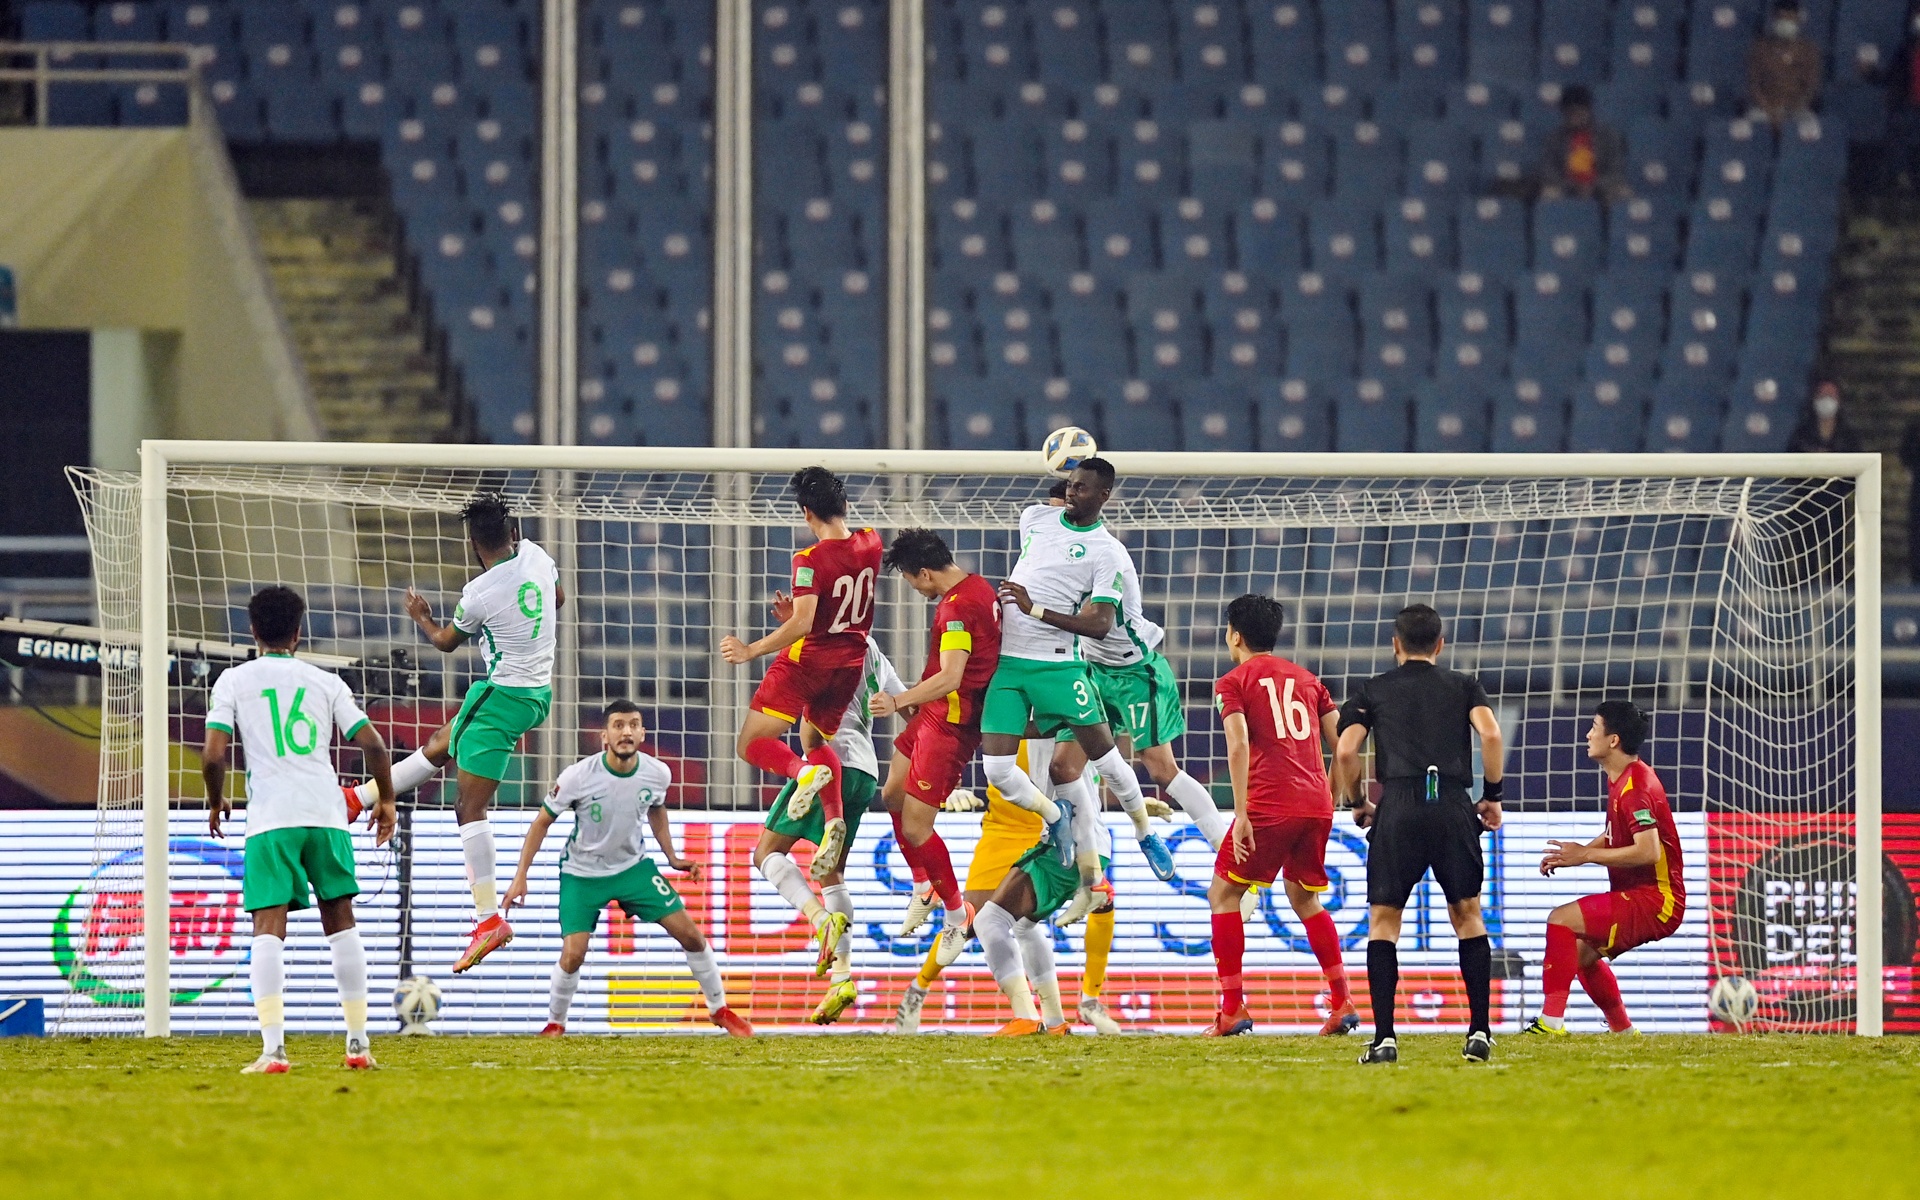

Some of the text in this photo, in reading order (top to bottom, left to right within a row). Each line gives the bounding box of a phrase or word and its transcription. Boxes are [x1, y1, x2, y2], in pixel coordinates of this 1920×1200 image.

[517, 581, 543, 639] 9
[828, 567, 874, 634] 20
[18, 637, 177, 672] EGRIPMET
[1073, 681, 1089, 706] 3
[1258, 677, 1311, 740] 16
[261, 687, 317, 757] 16
[1128, 702, 1149, 729] 17
[591, 803, 602, 823] 8
[652, 876, 671, 896] 8
